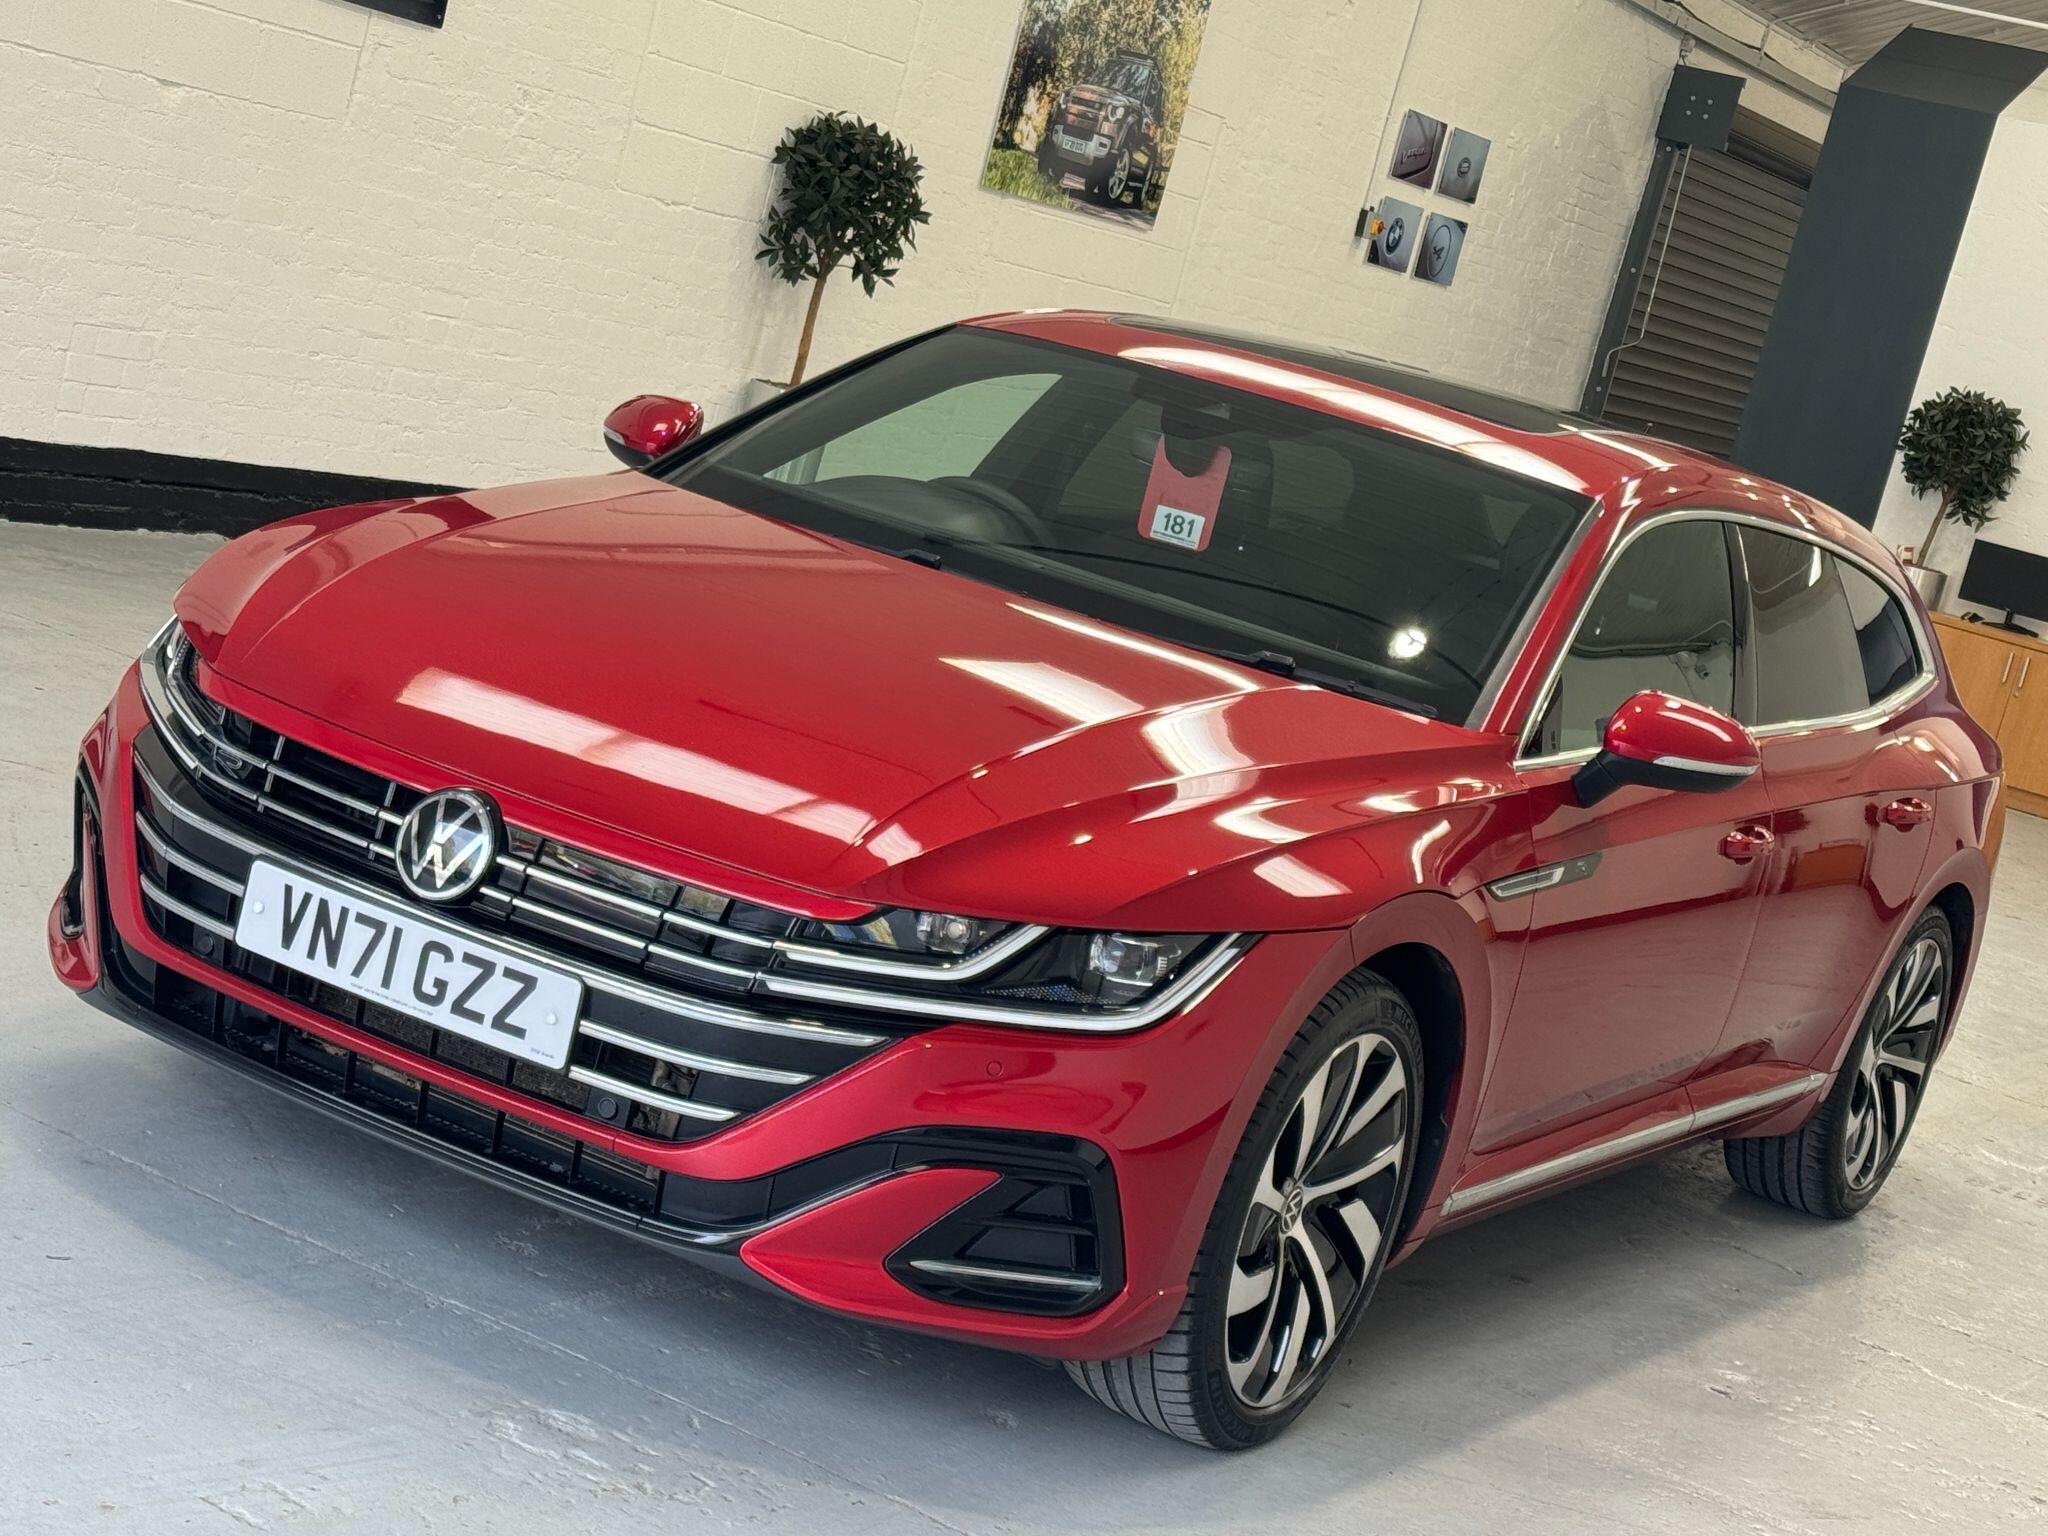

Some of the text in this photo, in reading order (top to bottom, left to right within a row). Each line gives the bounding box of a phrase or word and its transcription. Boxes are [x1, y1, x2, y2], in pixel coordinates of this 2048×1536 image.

[1163, 512, 1196, 538] 181
[281, 883, 539, 1041] VN71 GZZ
